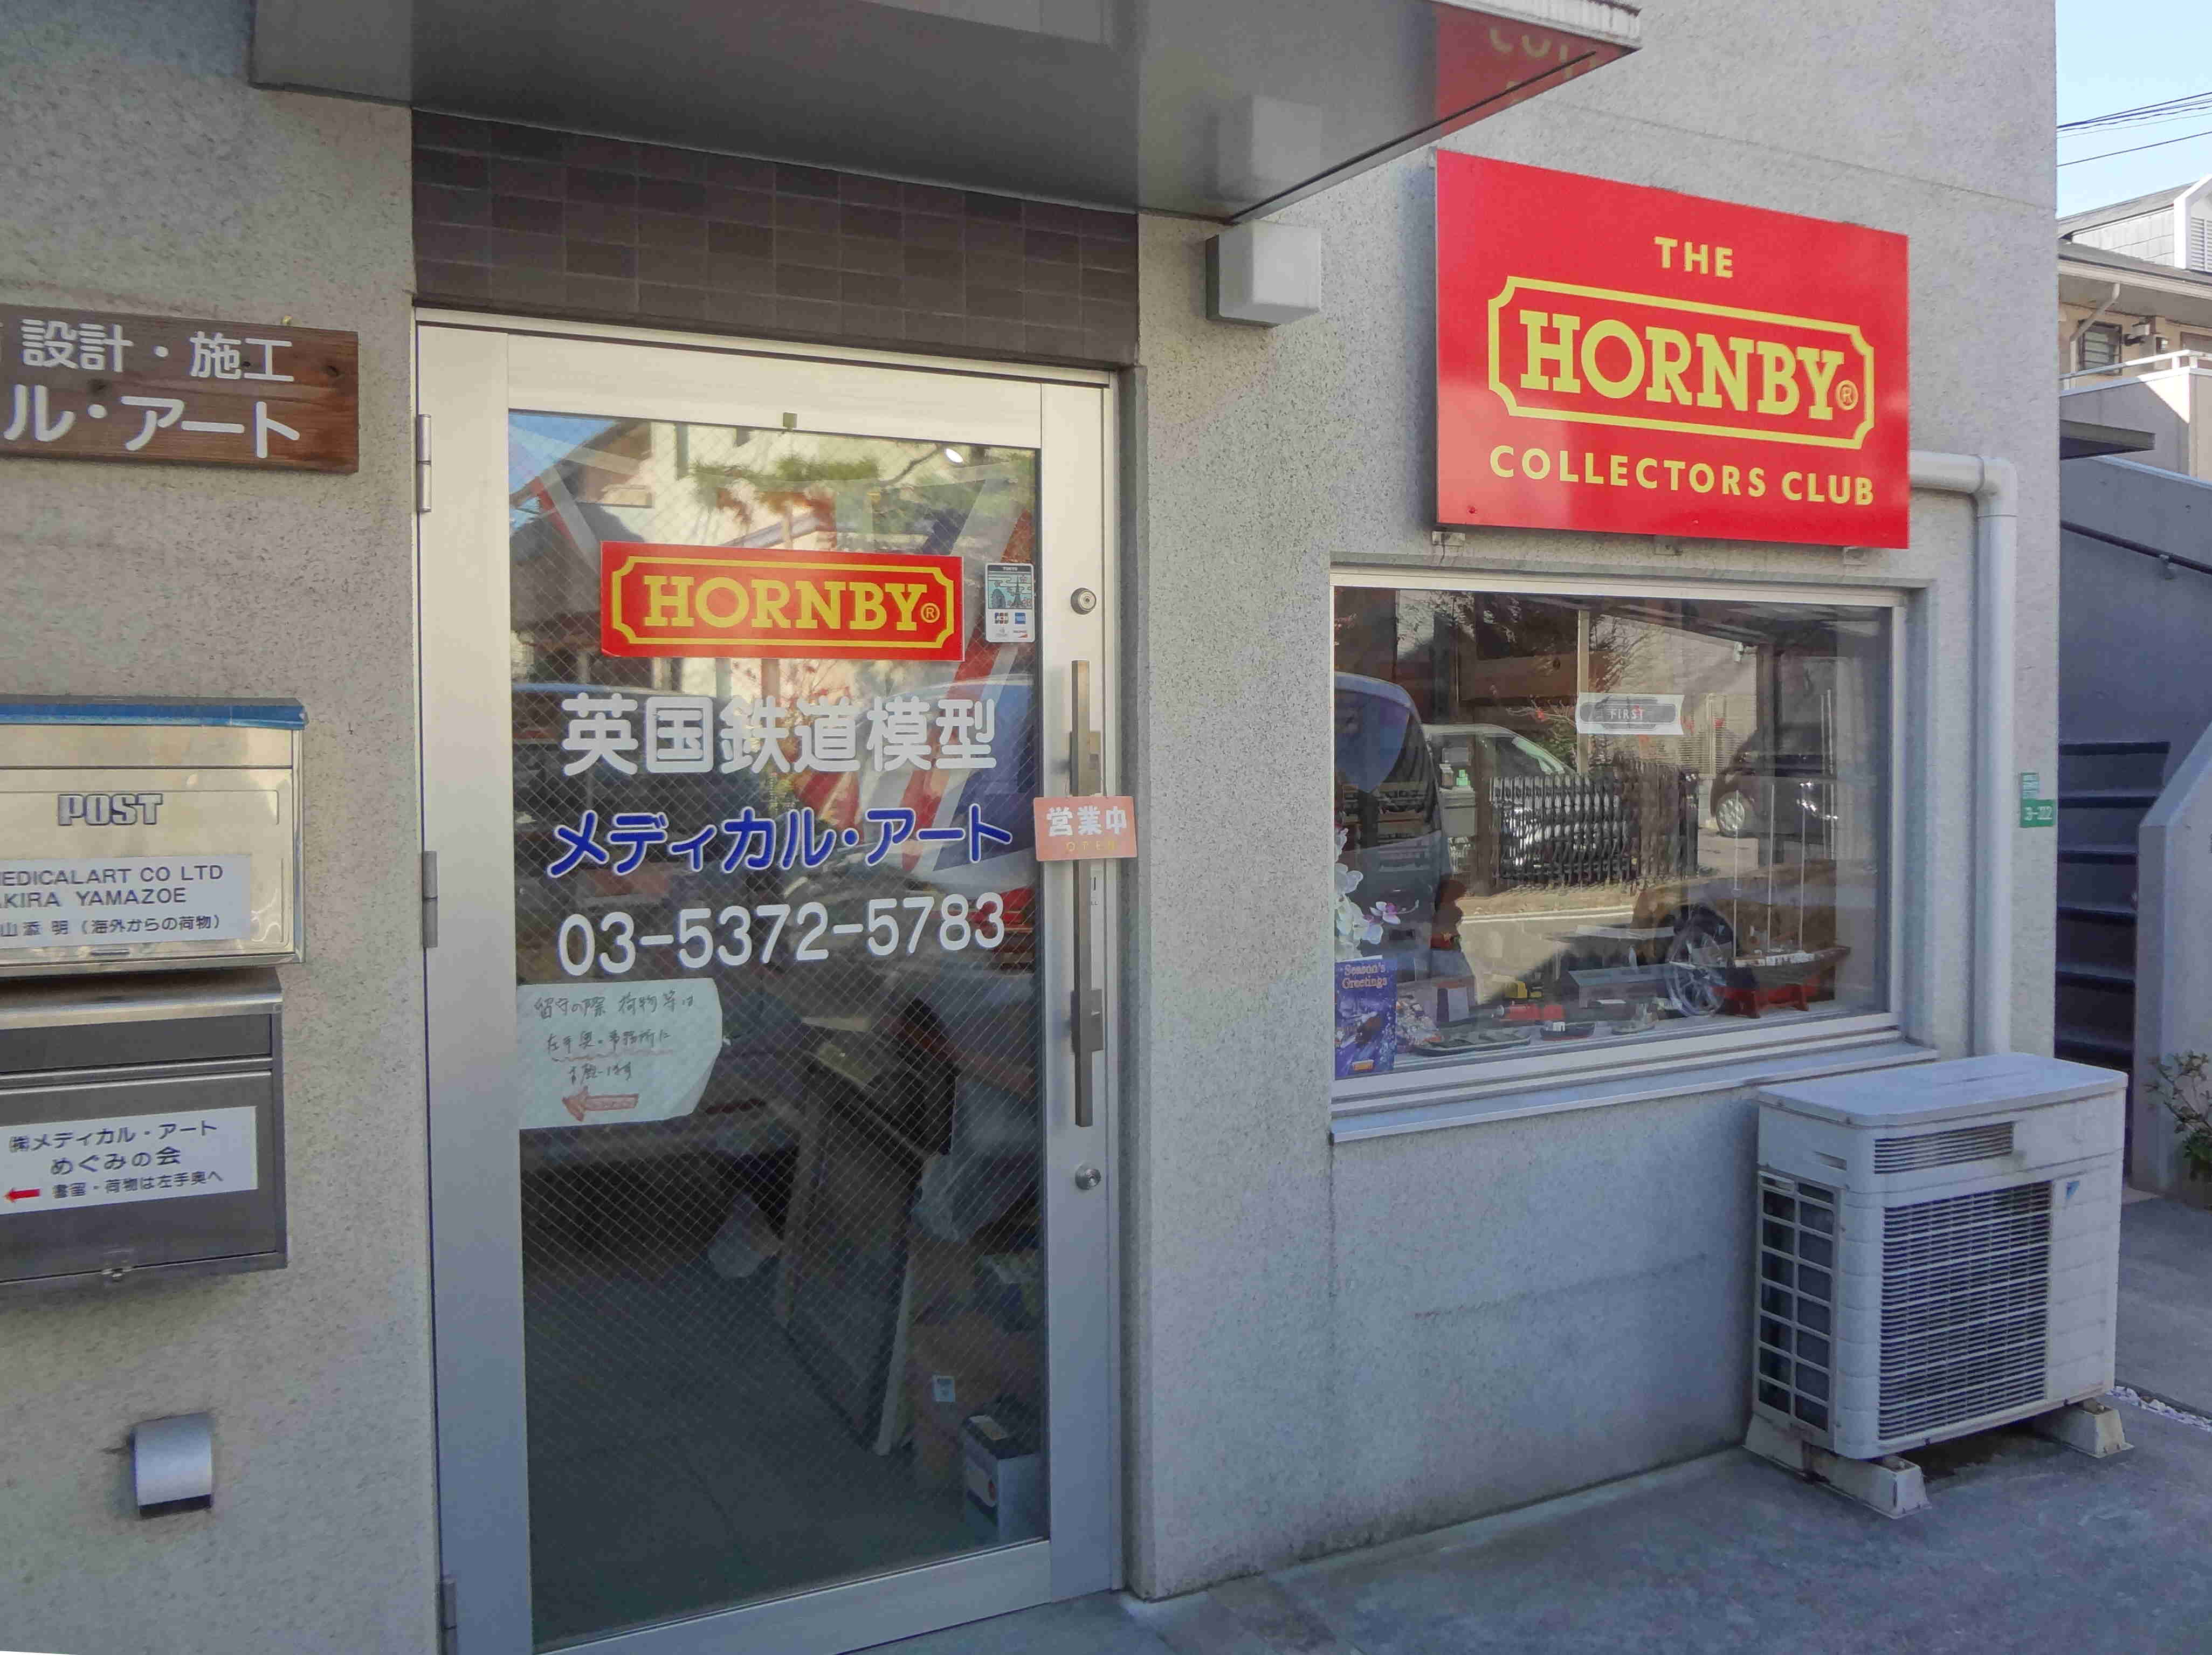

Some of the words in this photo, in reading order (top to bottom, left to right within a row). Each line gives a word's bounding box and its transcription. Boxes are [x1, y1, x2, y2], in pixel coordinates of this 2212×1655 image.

[1655, 236, 1733, 278] THE
[1490, 445, 1766, 498] COLLECTORS
[1782, 471, 1874, 506] CLUB
[1609, 708, 1645, 721] FIRST
[561, 692, 997, 777] 英国鉄道模型
[58, 793, 163, 826] POST
[1046, 804, 1127, 837] 営業中
[547, 803, 1012, 879] メディカル・アート
[0, 868, 132, 886] EDICALART
[140, 866, 170, 882] CO
[181, 865, 223, 881] LTD
[0, 891, 61, 909] KIRA
[75, 887, 187, 906] YAMAZOE
[557, 891, 1005, 977] 03-5372-5783
[1341, 976, 1388, 989] Greetings
[50, 1146, 182, 1176] めぐみの会
